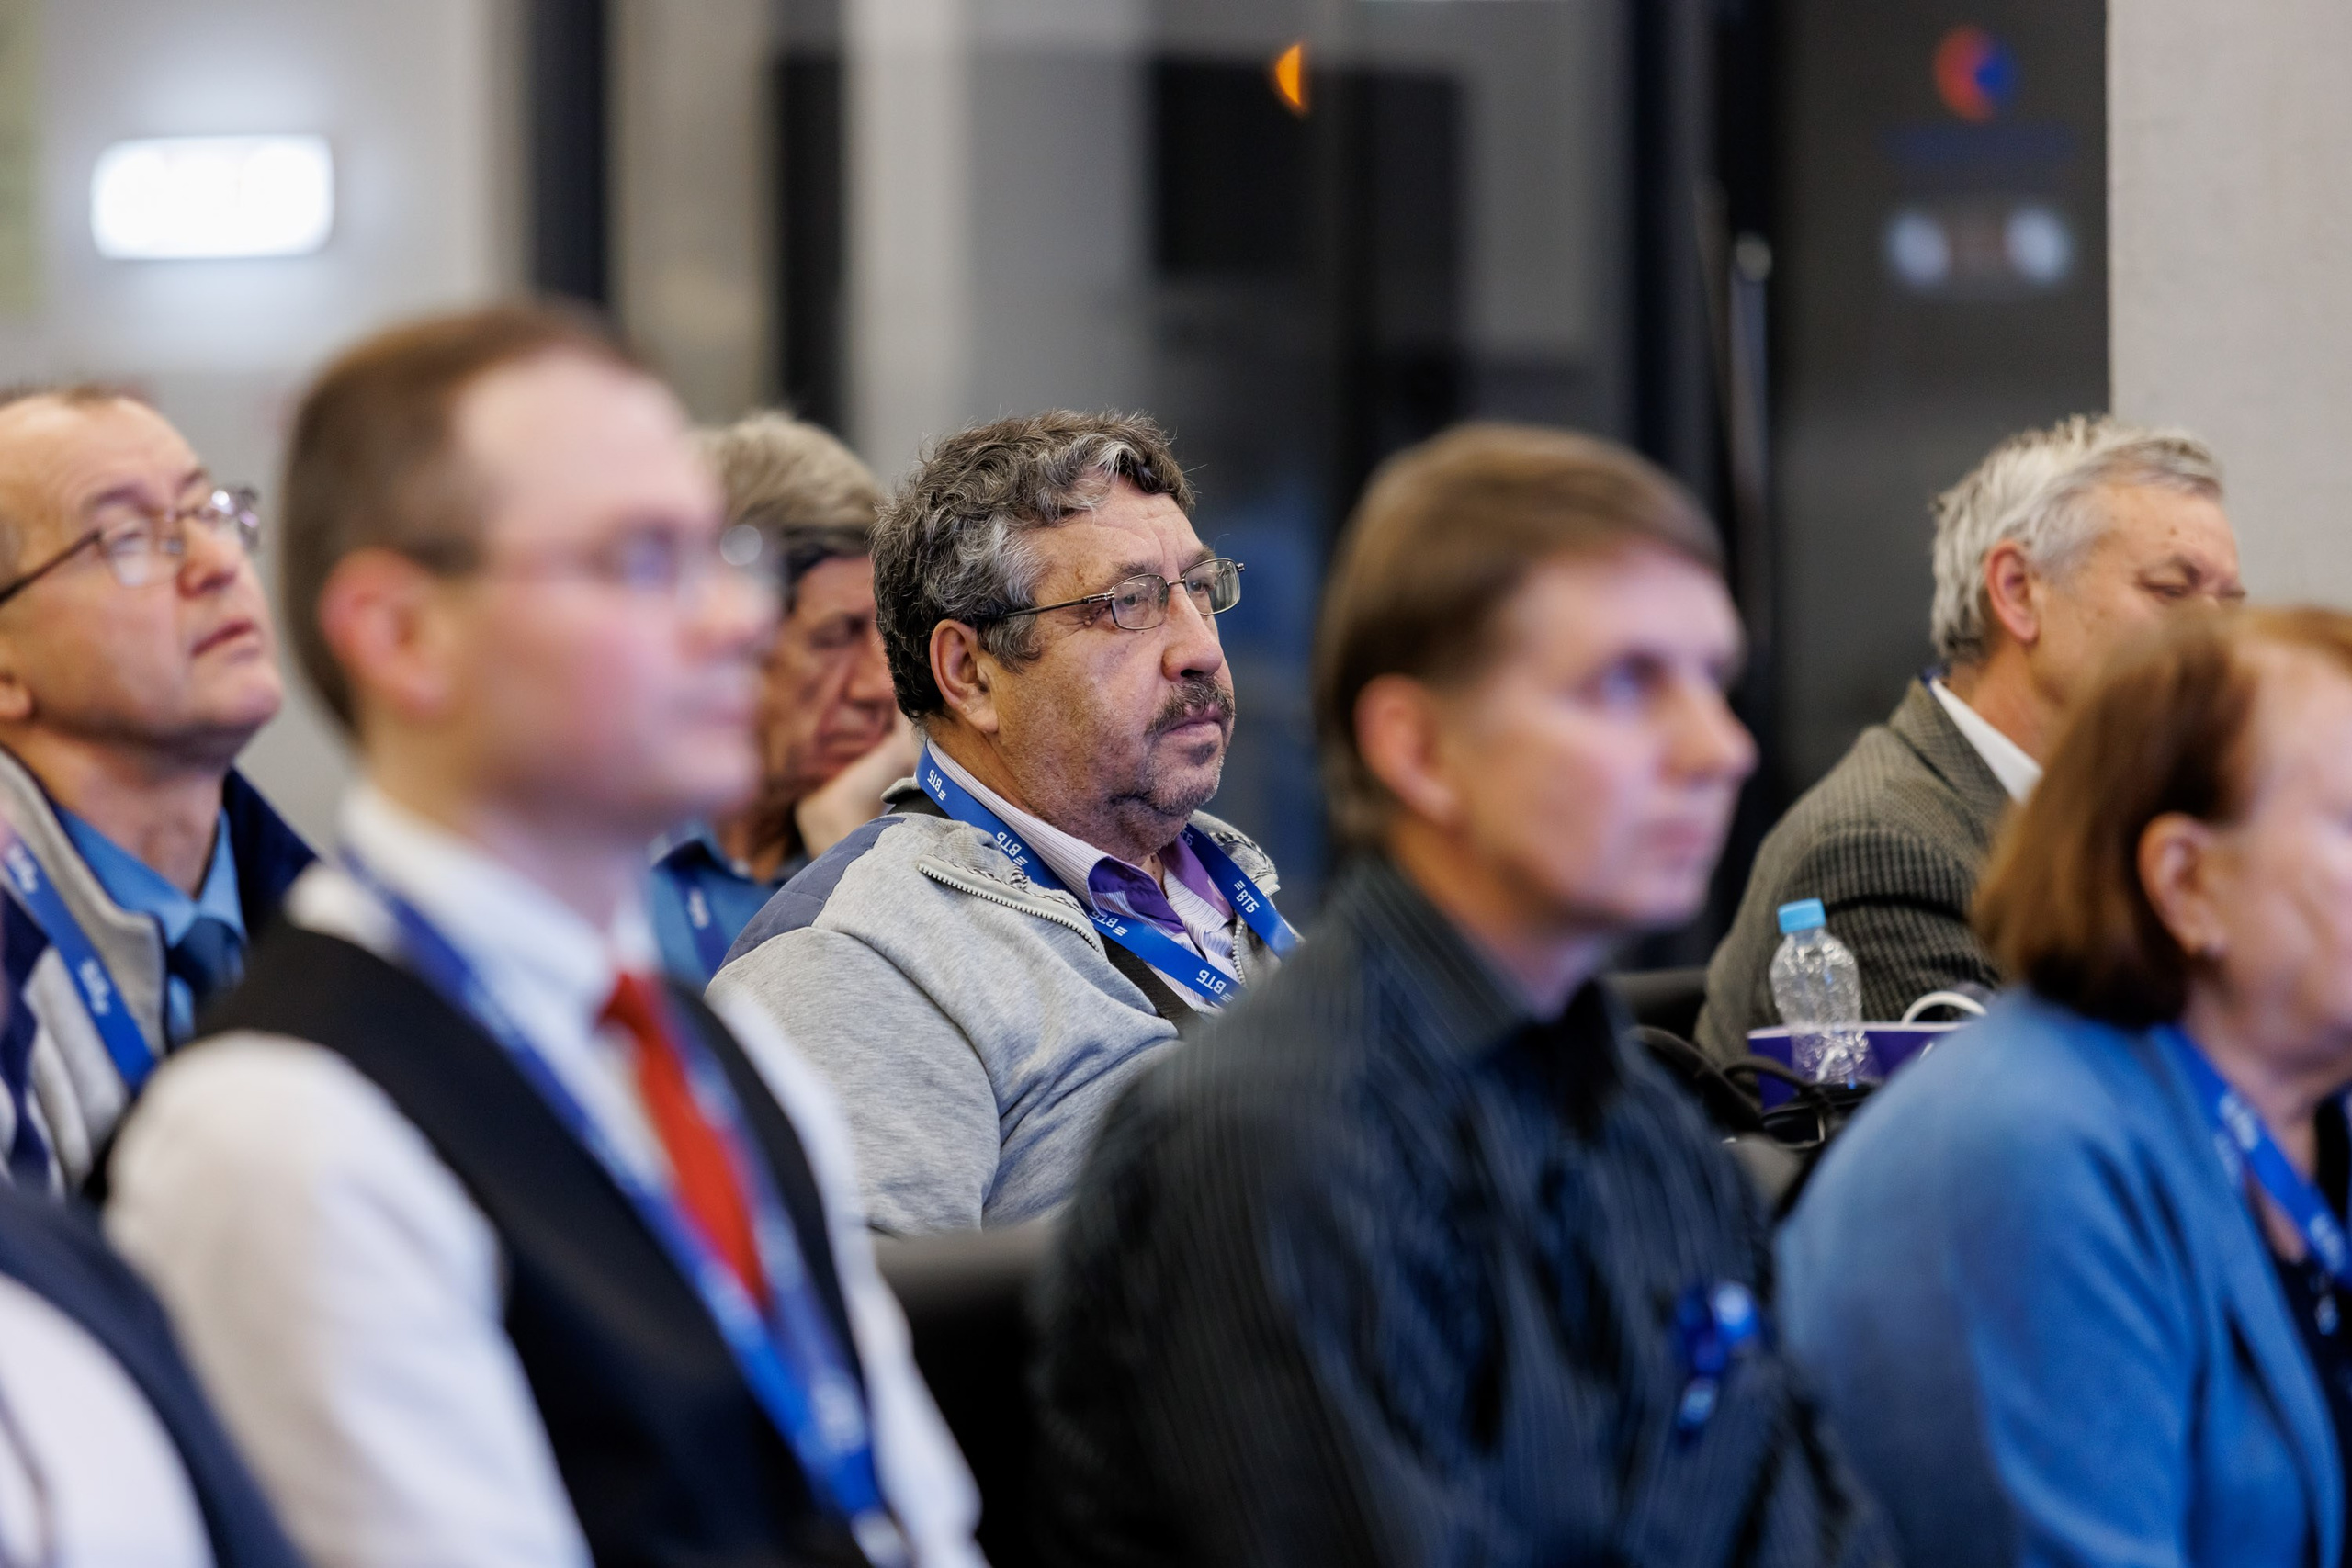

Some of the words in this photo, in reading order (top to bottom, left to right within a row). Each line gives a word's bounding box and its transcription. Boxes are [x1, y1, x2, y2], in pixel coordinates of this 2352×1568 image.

[927, 769, 943, 792] ВТБ
[1236, 889, 1260, 913] ВТБ
[1089, 911, 1119, 928] ВТБ
[1195, 969, 1227, 994] ВТБ
